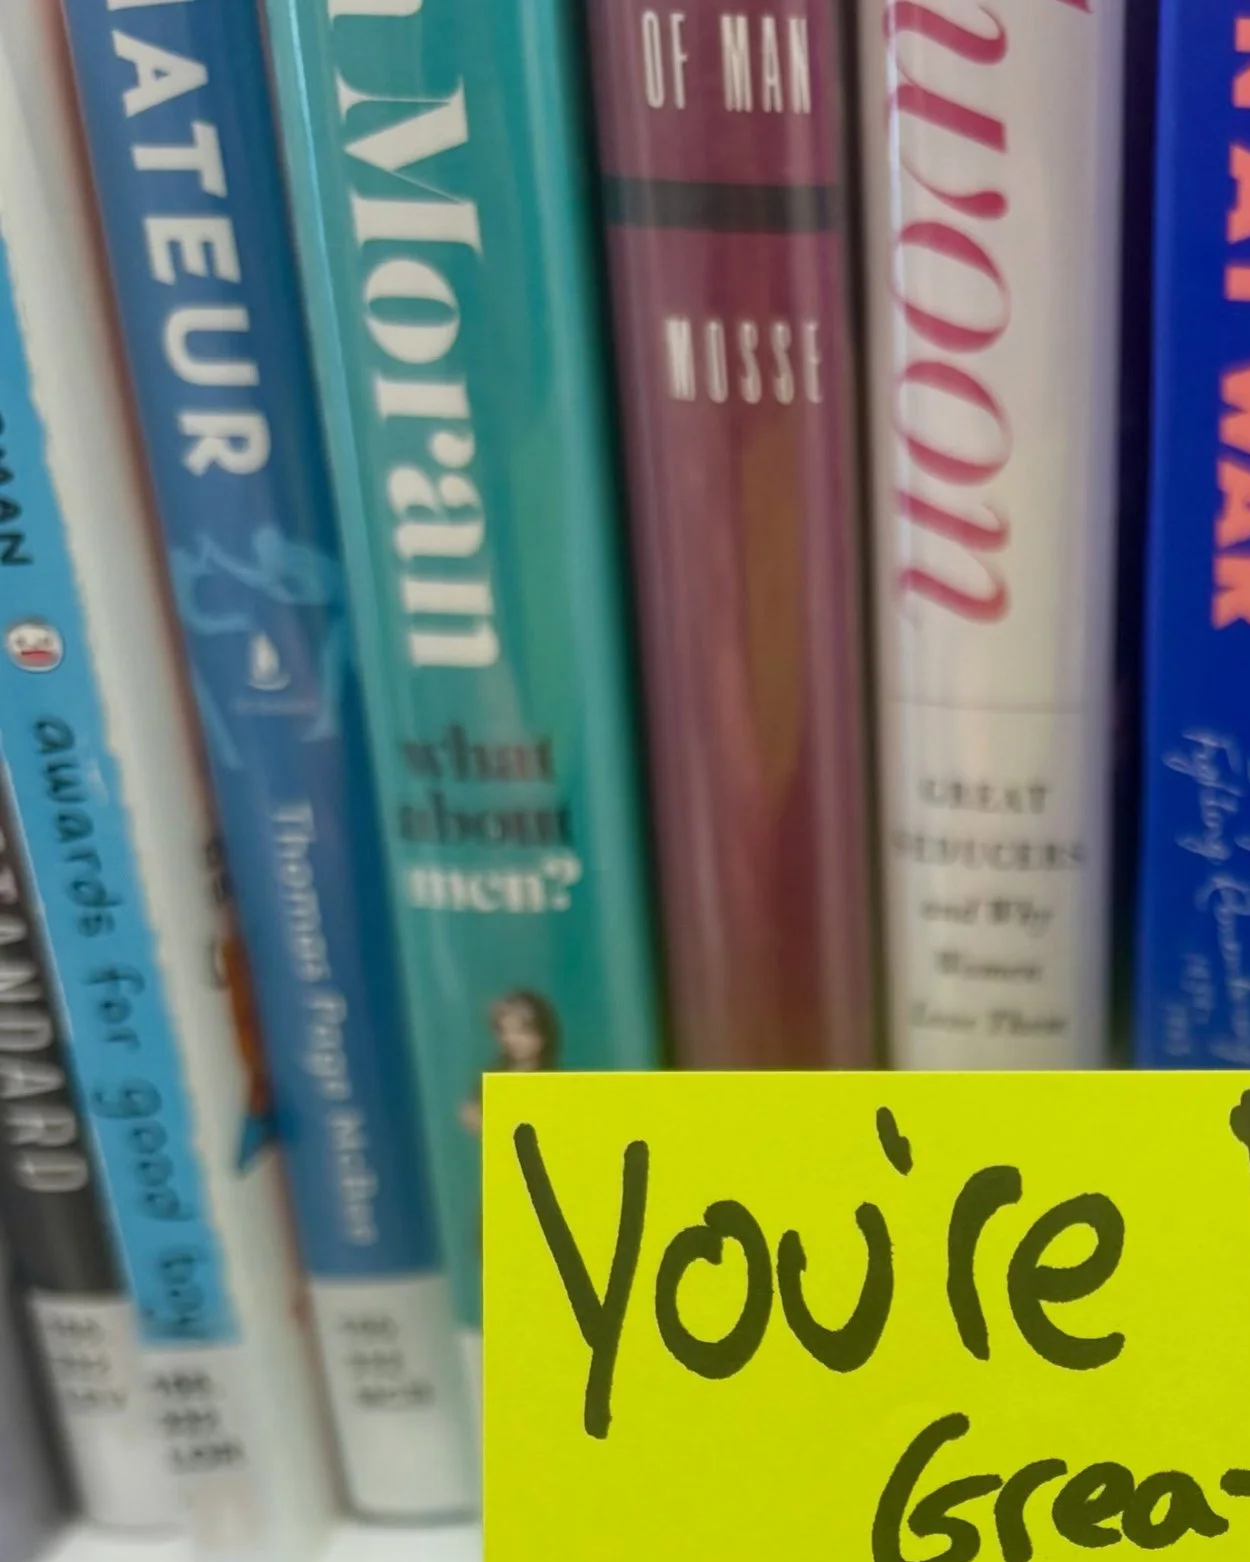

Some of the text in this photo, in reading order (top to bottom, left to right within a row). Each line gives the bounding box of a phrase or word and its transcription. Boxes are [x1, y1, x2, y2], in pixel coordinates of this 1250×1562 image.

[640, 9, 812, 113] OF MAN
[108, 0, 272, 477] ATEUR
[337, 75, 500, 668] Moran
[665, 317, 823, 405] MOSSE
[406, 854, 582, 914] men?
[84, 964, 146, 1052] for
[512, 1105, 1127, 1440] You're
